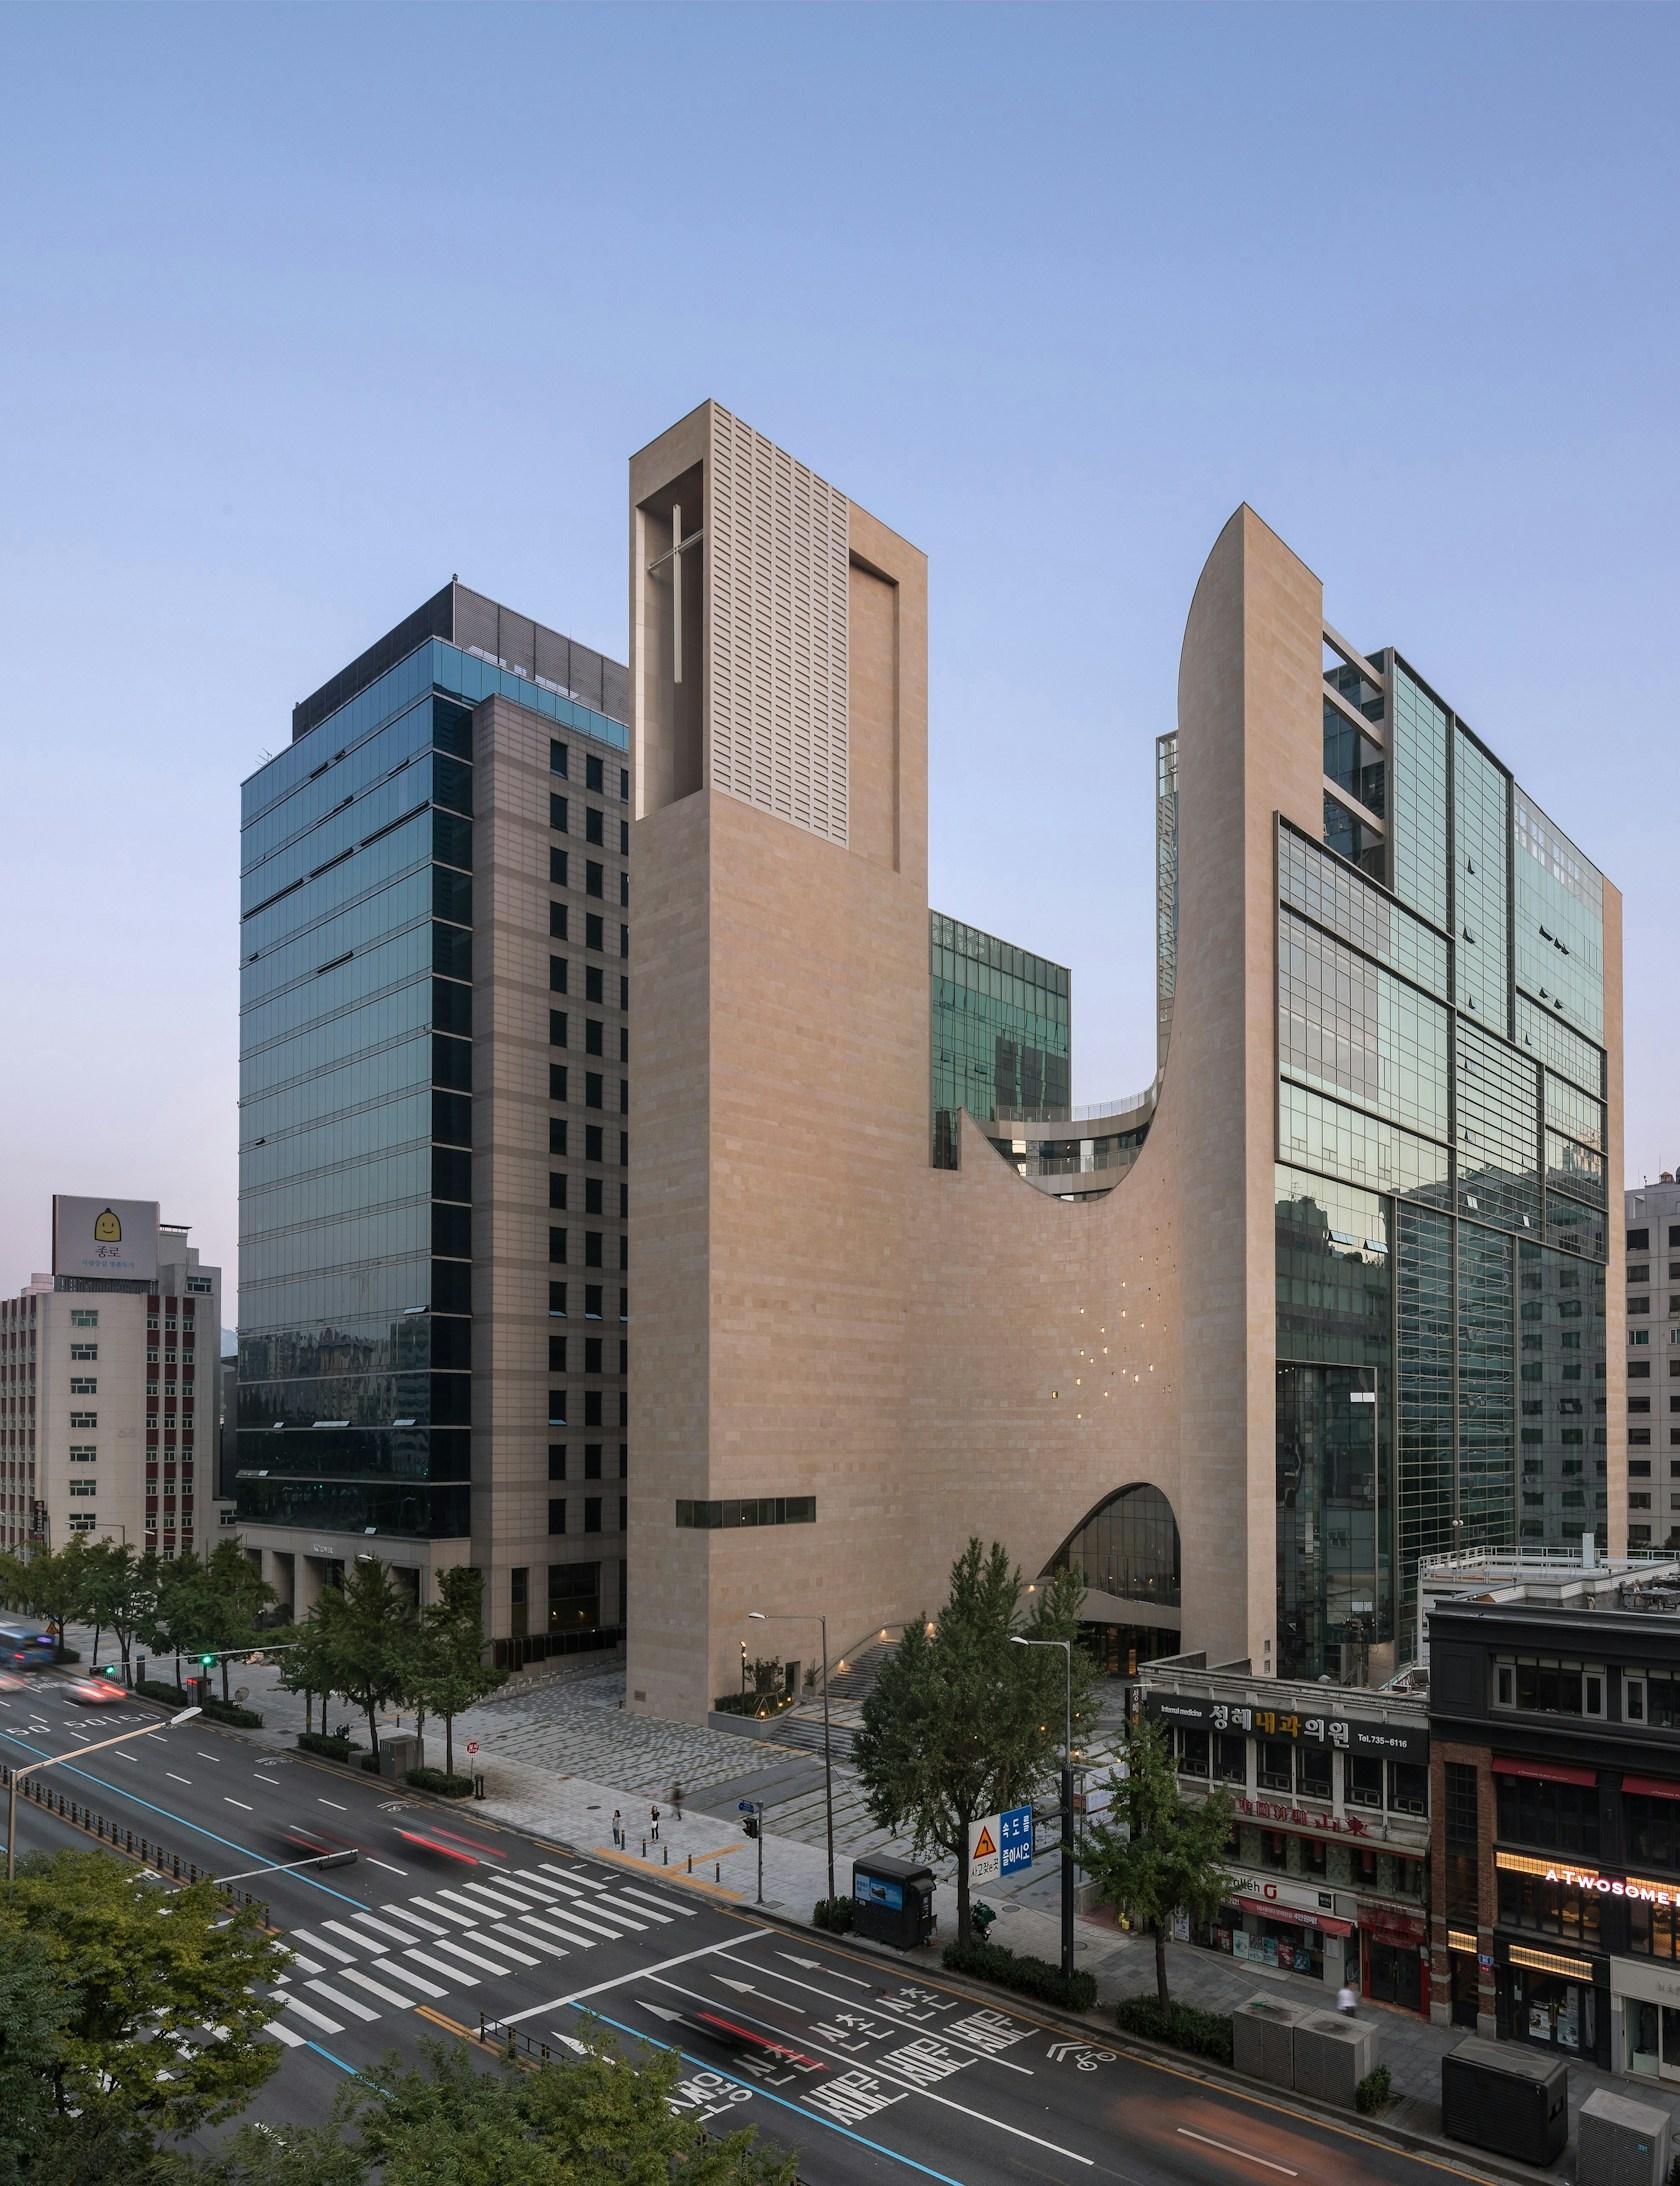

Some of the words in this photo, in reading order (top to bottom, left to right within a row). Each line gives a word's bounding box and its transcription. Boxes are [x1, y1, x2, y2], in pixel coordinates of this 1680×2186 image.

[96, 1246, 121, 1258] 종로
[5, 1724, 52, 1736] 50
[63, 1718, 107, 1730] 50
[118, 1712, 161, 1723] 50
[1002, 1815, 1030, 1838] 속도를
[1002, 1842, 1030, 1867] 줄이시오
[1562, 1870, 1670, 1906] TWOSOME
[875, 1987, 959, 2022] 신촌
[808, 2014, 896, 2052] 신촌
[942, 2008, 1041, 2054] 서대문
[732, 2044, 825, 2086] 신촌
[875, 2037, 979, 2087] 서대문
[800, 2070, 910, 2126] 서대문
